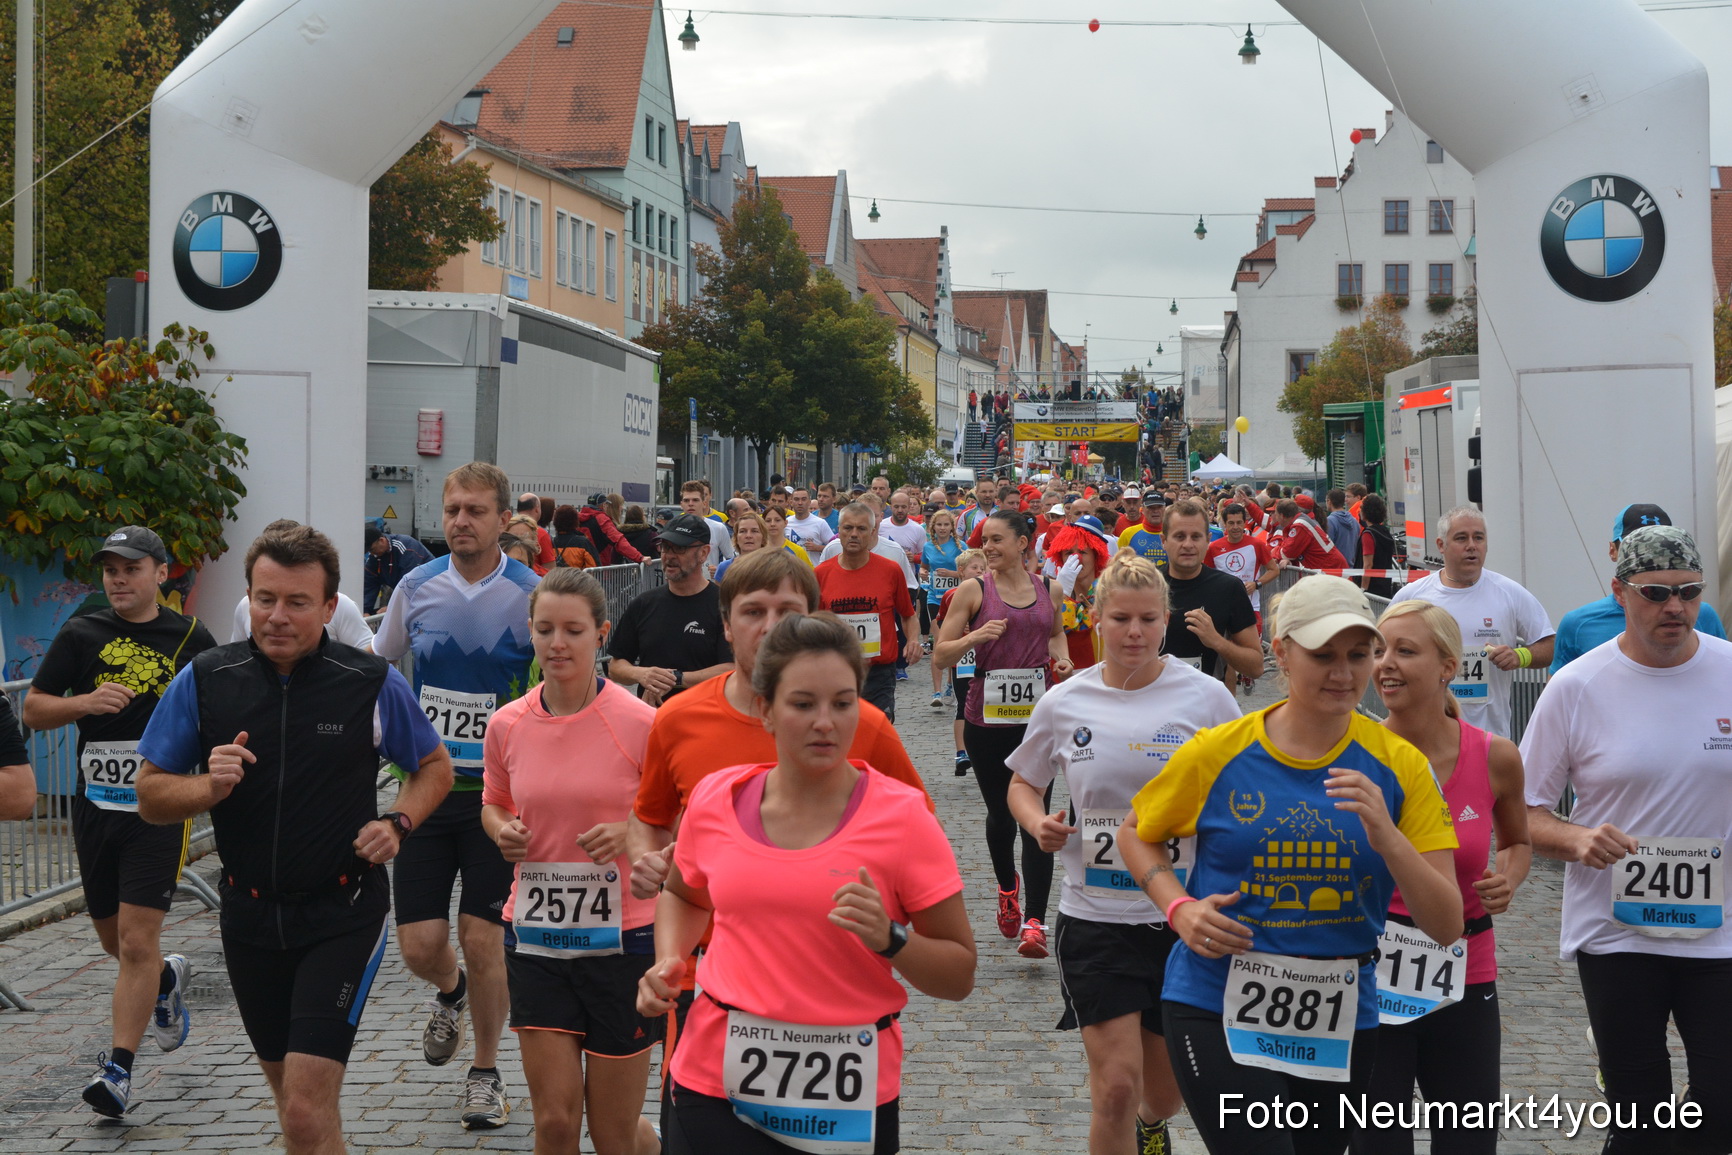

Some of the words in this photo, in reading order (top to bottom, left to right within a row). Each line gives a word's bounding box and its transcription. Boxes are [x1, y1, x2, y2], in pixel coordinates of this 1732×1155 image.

[1550, 178, 1656, 220] BMW
[180, 194, 274, 233] BMW
[623, 392, 653, 437] BOCK
[1054, 426, 1098, 437] START
[935, 577, 959, 588] 2760
[689, 627, 705, 635] Frank
[421, 692, 444, 704] PARTL
[445, 697, 482, 709] Neumarkt
[997, 682, 1035, 703] 194
[997, 707, 1031, 716] Rebecca
[317, 723, 344, 732] GORE
[425, 705, 488, 740] 2125
[84, 748, 108, 756] PARTL
[444, 743, 462, 758] igi
[1071, 748, 1094, 758] PARTL
[1071, 755, 1095, 763] Neumarkt
[89, 758, 145, 785] 292
[1084, 817, 1120, 827] PARTL
[1459, 813, 1479, 822] adidas
[1094, 831, 1181, 866] 28
[1656, 846, 1708, 858] Neumarkt
[520, 872, 549, 882] PARTL
[551, 872, 601, 882] Neumarkt
[1255, 872, 1323, 883] 21.September
[1325, 874, 1349, 882] 2014
[1624, 860, 1711, 900] 2401
[524, 886, 612, 924] 2574
[1237, 914, 1365, 928] www.stadtlauf-neumarkt.de
[1642, 907, 1697, 924] Markus
[542, 932, 591, 948] Regina
[1394, 933, 1448, 953] Neumarkt
[1233, 958, 1279, 978] PARTL
[1281, 968, 1341, 984] Neumarkt
[1376, 948, 1454, 997] 114
[336, 982, 351, 1008] GORE
[1377, 994, 1427, 1015] Andrea
[1236, 980, 1344, 1032] 2881
[729, 1024, 779, 1042] PARTL
[782, 1030, 852, 1045] Neumarkt
[1256, 1037, 1317, 1061] Sabrina
[738, 1047, 863, 1103] 2726
[759, 1111, 838, 1136] Jennifer
